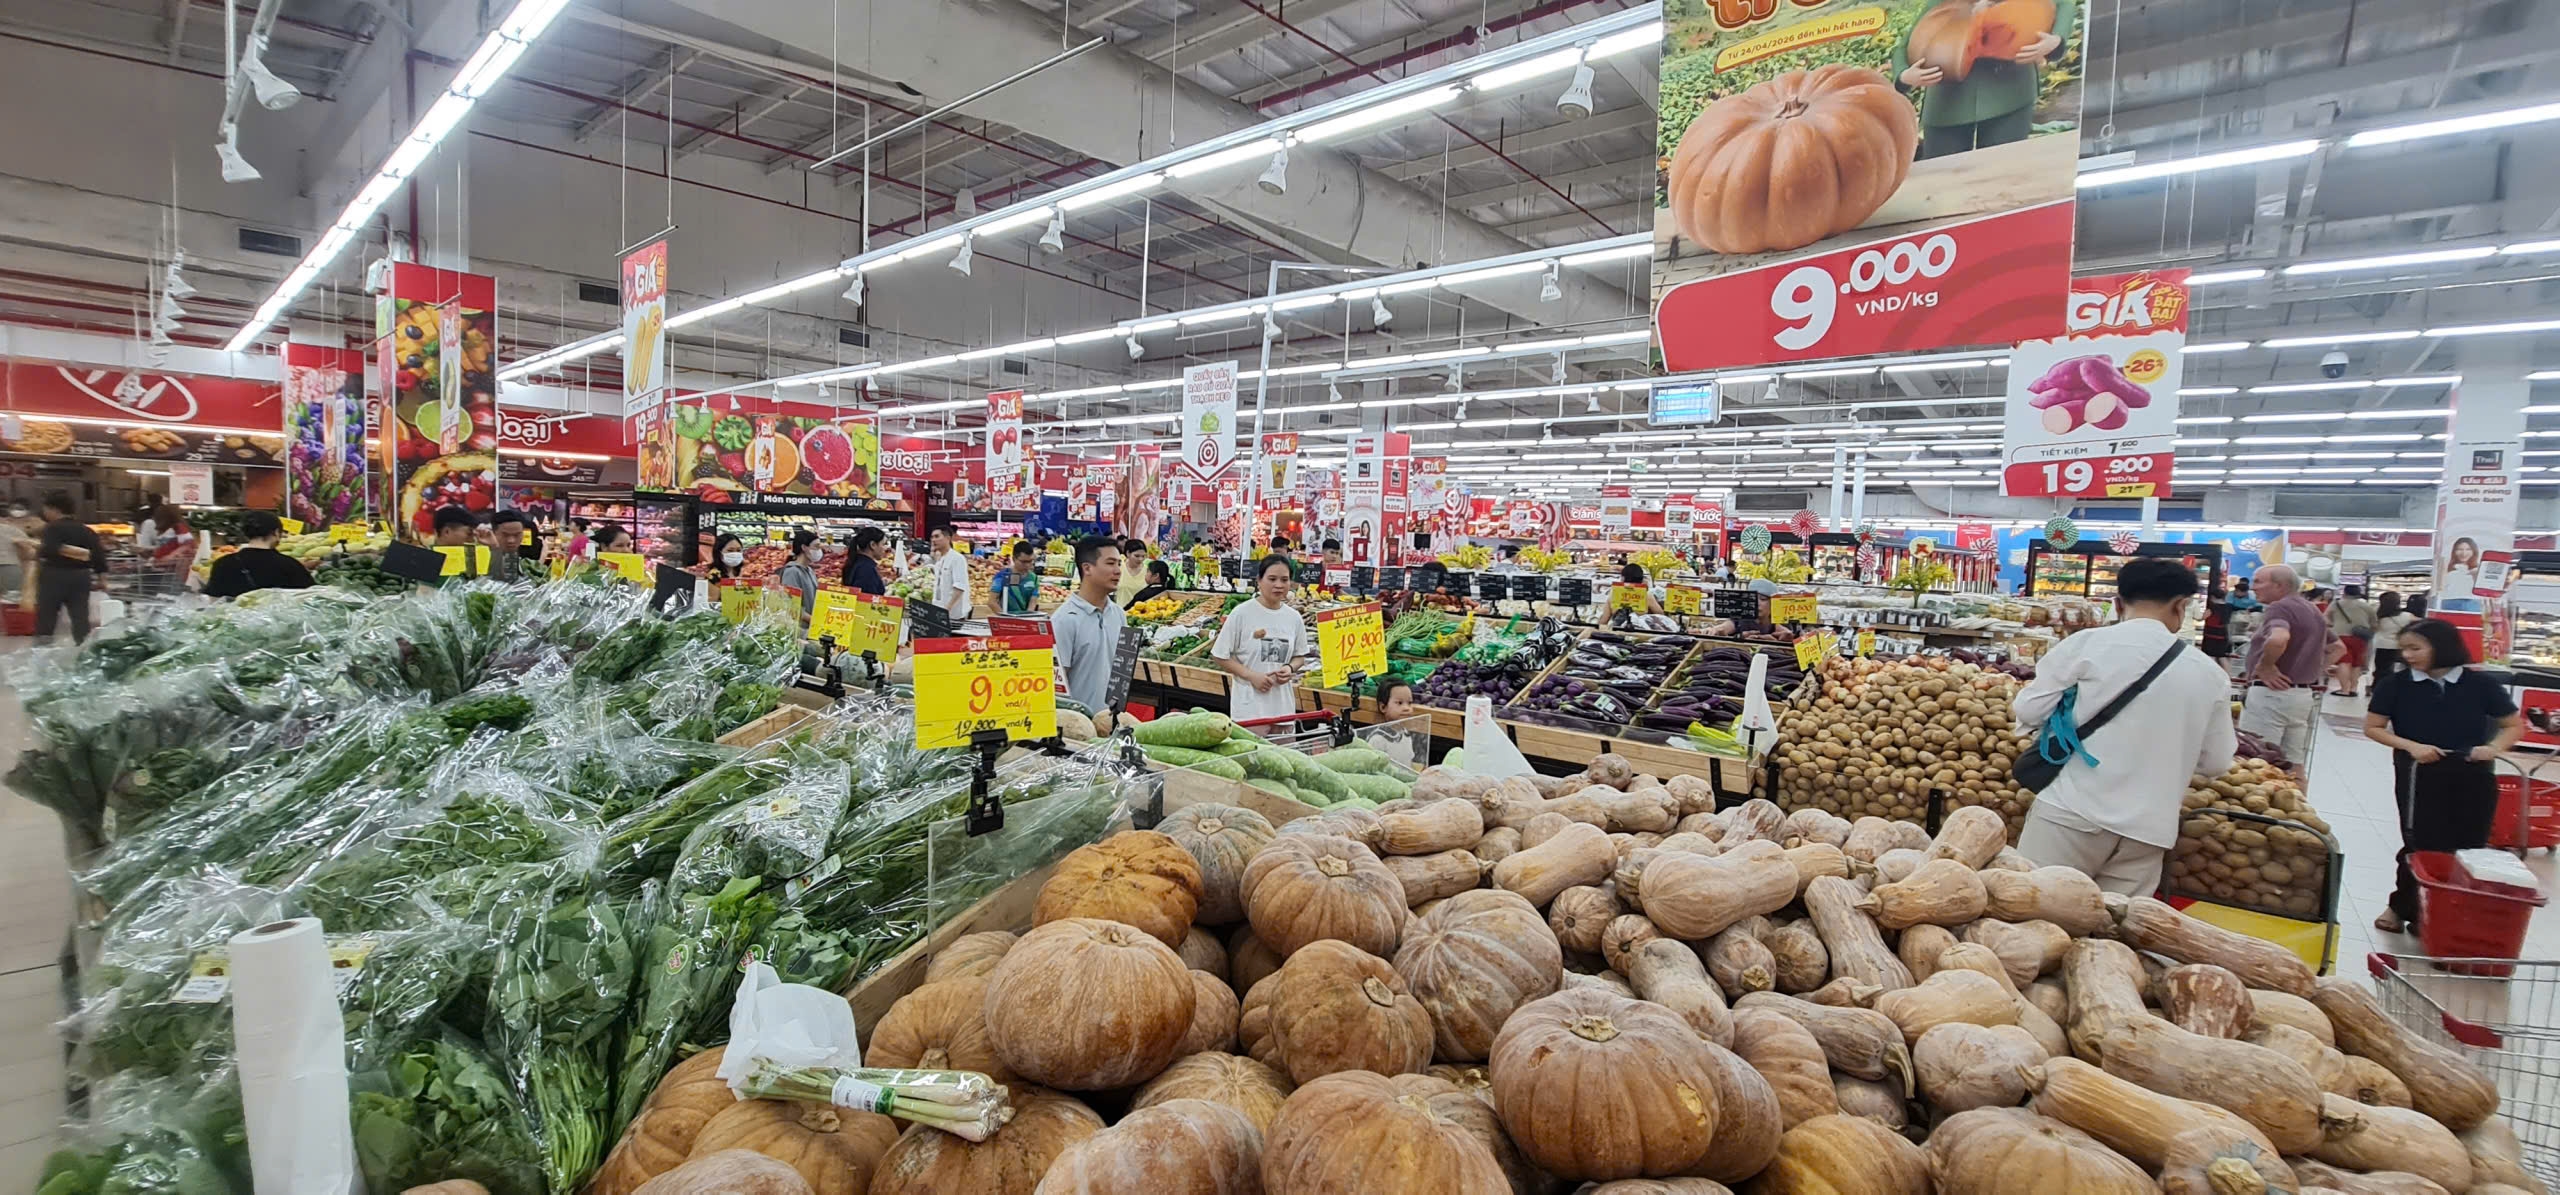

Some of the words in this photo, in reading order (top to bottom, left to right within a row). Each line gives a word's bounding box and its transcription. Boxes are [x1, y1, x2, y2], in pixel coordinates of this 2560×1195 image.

[1741, 34, 1795, 56] 24/04/2026
[1816, 25, 1831, 36] khi
[1833, 20, 1849, 33] hết
[1851, 16, 1876, 27] hàng
[1771, 233, 1957, 350] 9.000
[1855, 291, 1939, 317] VND/kg
[763, 494, 785, 504] Món
[785, 497, 809, 506] ngon
[810, 497, 827, 505] cho
[828, 497, 846, 507] mọi
[846, 499, 863, 507] GU!
